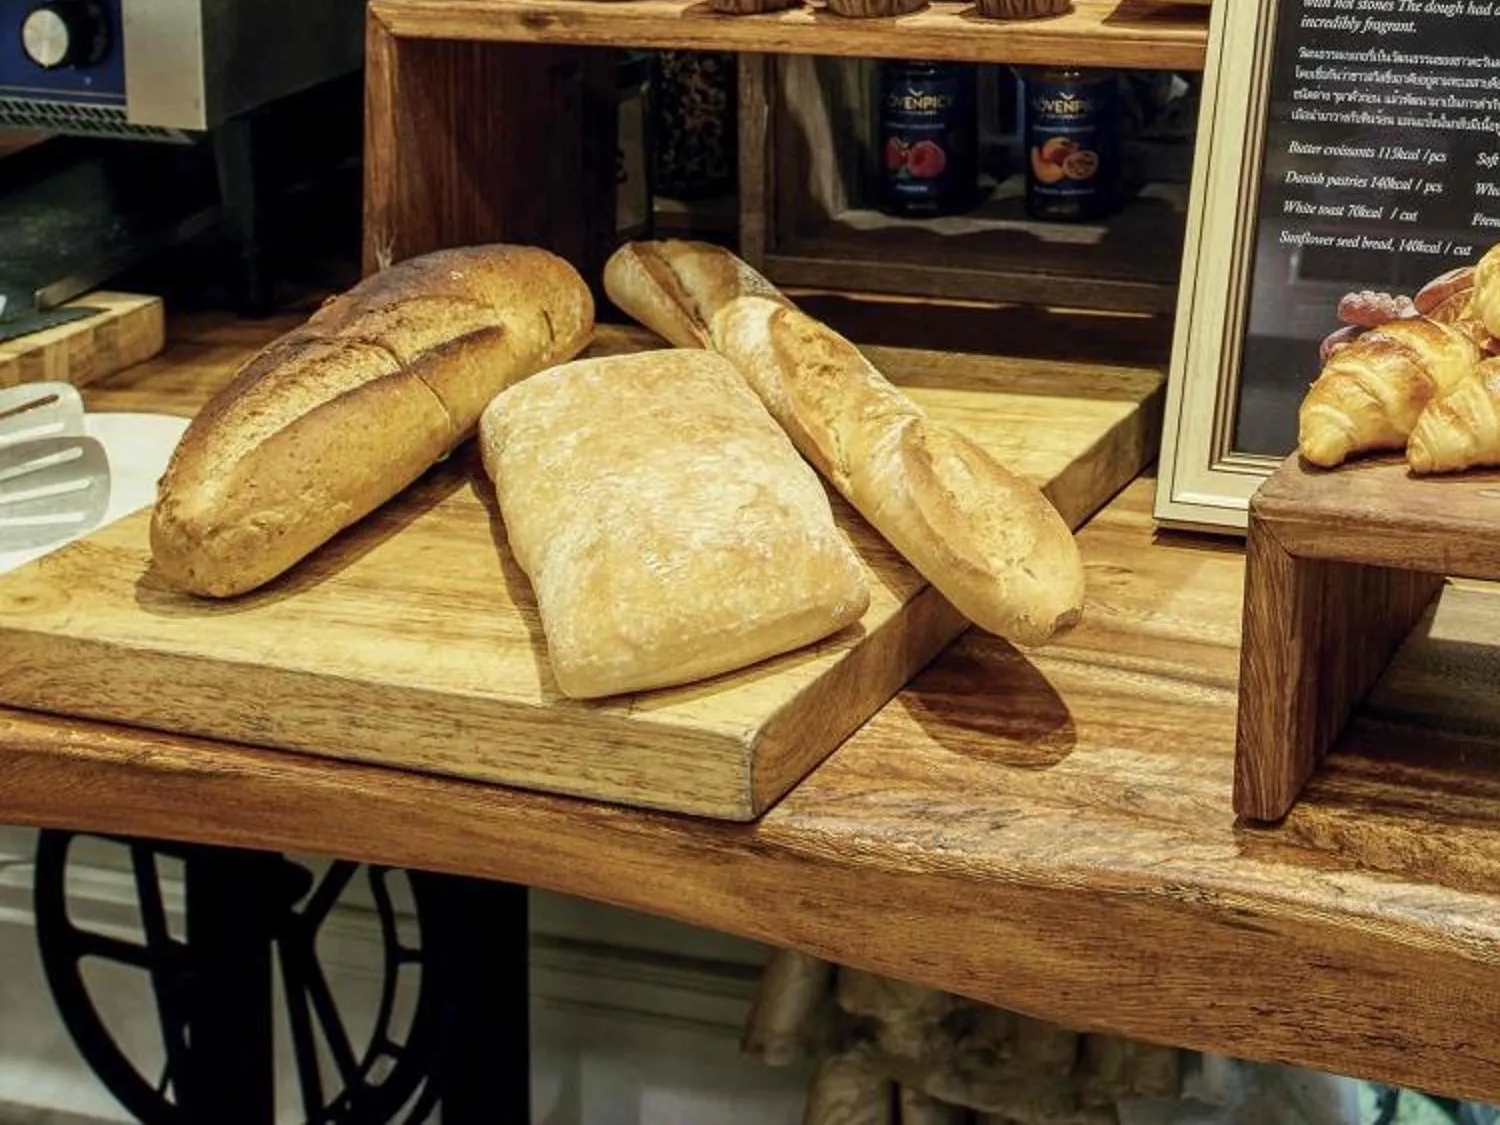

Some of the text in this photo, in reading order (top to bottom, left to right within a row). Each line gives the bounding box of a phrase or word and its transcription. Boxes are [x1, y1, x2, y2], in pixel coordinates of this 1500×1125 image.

[1423, 0, 1464, 17] dough
[1467, 0, 1492, 16] had
[1300, 15, 1417, 35] incredibly fragrant.
[1288, 141, 1322, 154] Butter
[1475, 152, 1500, 168] Soft
[1326, 175, 1368, 188] pastries
[1423, 183, 1443, 195] pcs
[1283, 200, 1317, 214] White
[1279, 231, 1335, 247] Sunflower
[1336, 234, 1361, 248] seed
